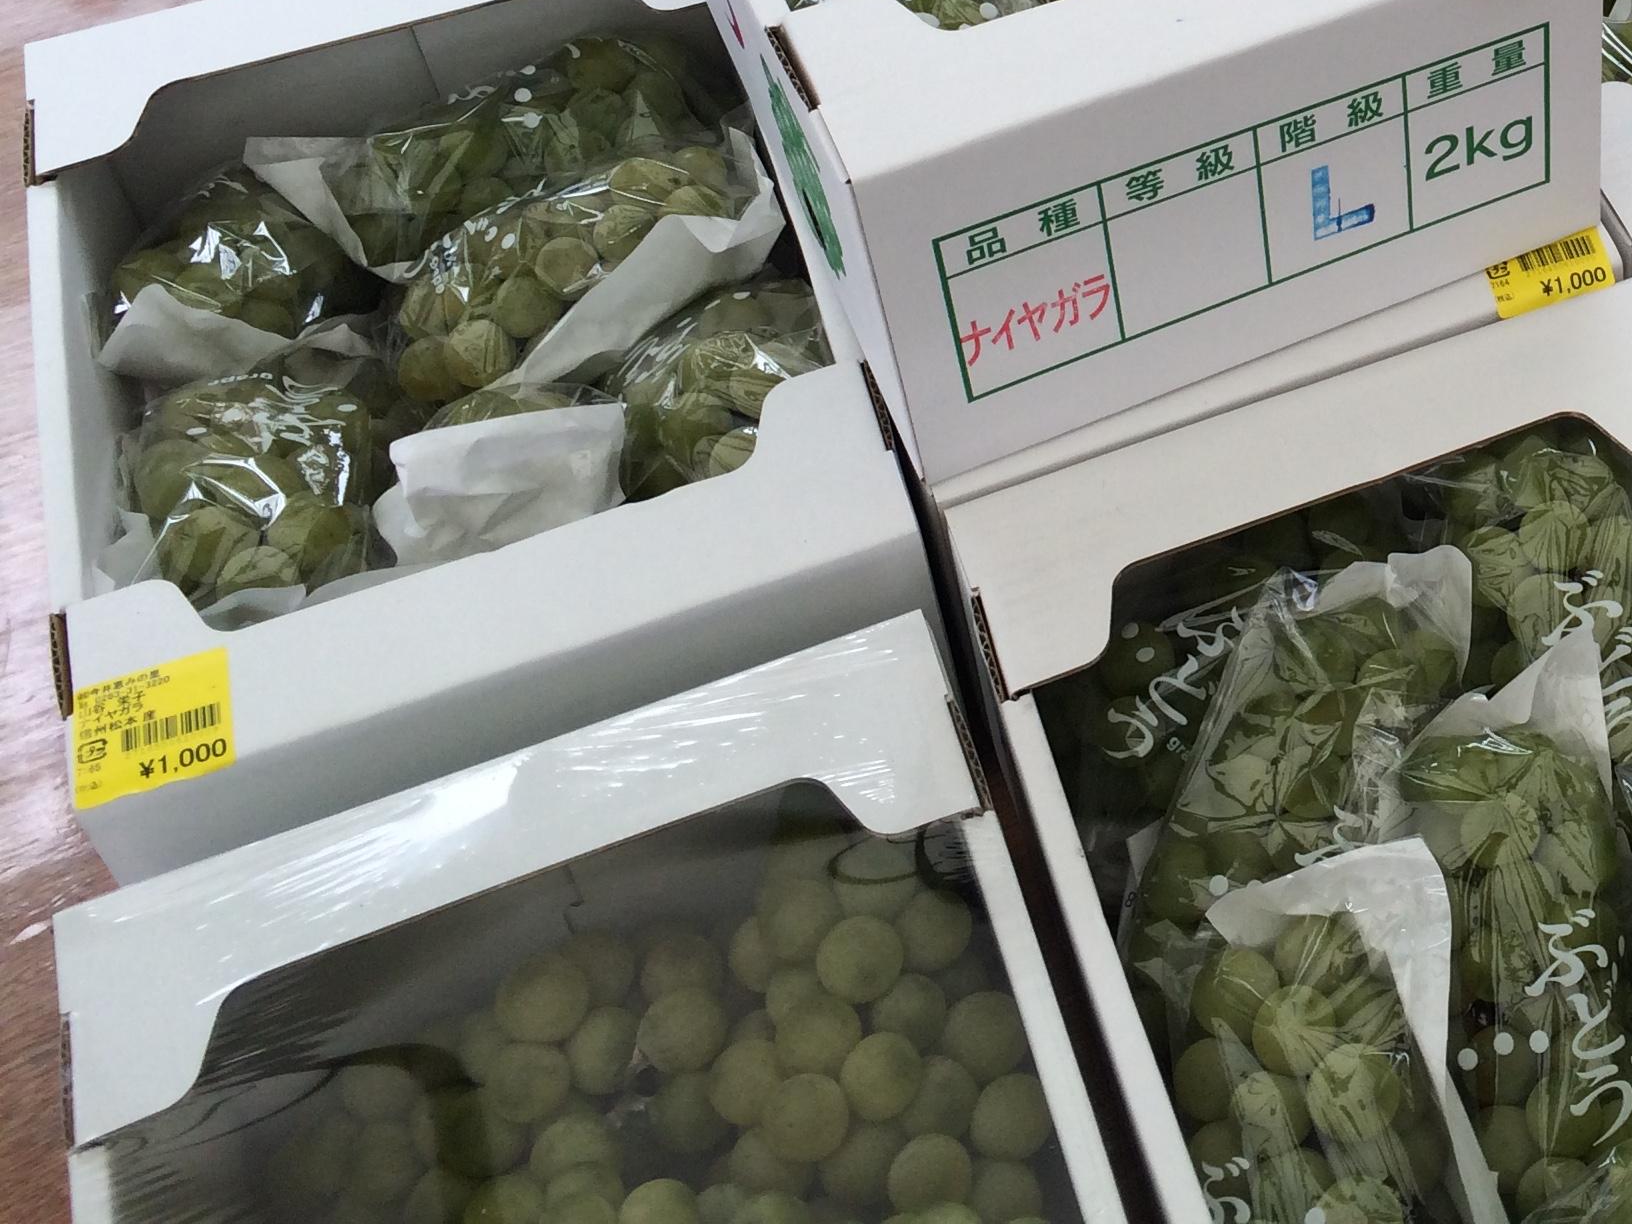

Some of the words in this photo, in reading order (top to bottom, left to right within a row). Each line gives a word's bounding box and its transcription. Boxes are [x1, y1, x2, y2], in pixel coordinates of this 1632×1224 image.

[1426, 38, 1527, 100] 重量
[1278, 91, 1384, 153] 階級
[1425, 113, 1533, 181] 2kg
[1125, 143, 1235, 203] 等級
[1311, 165, 1375, 241] L
[965, 196, 1082, 264] 品種
[1540, 266, 1607, 296] ¥1,000
[960, 273, 1110, 366] ナイヤガラ
[139, 738, 227, 778] ¥1,000
